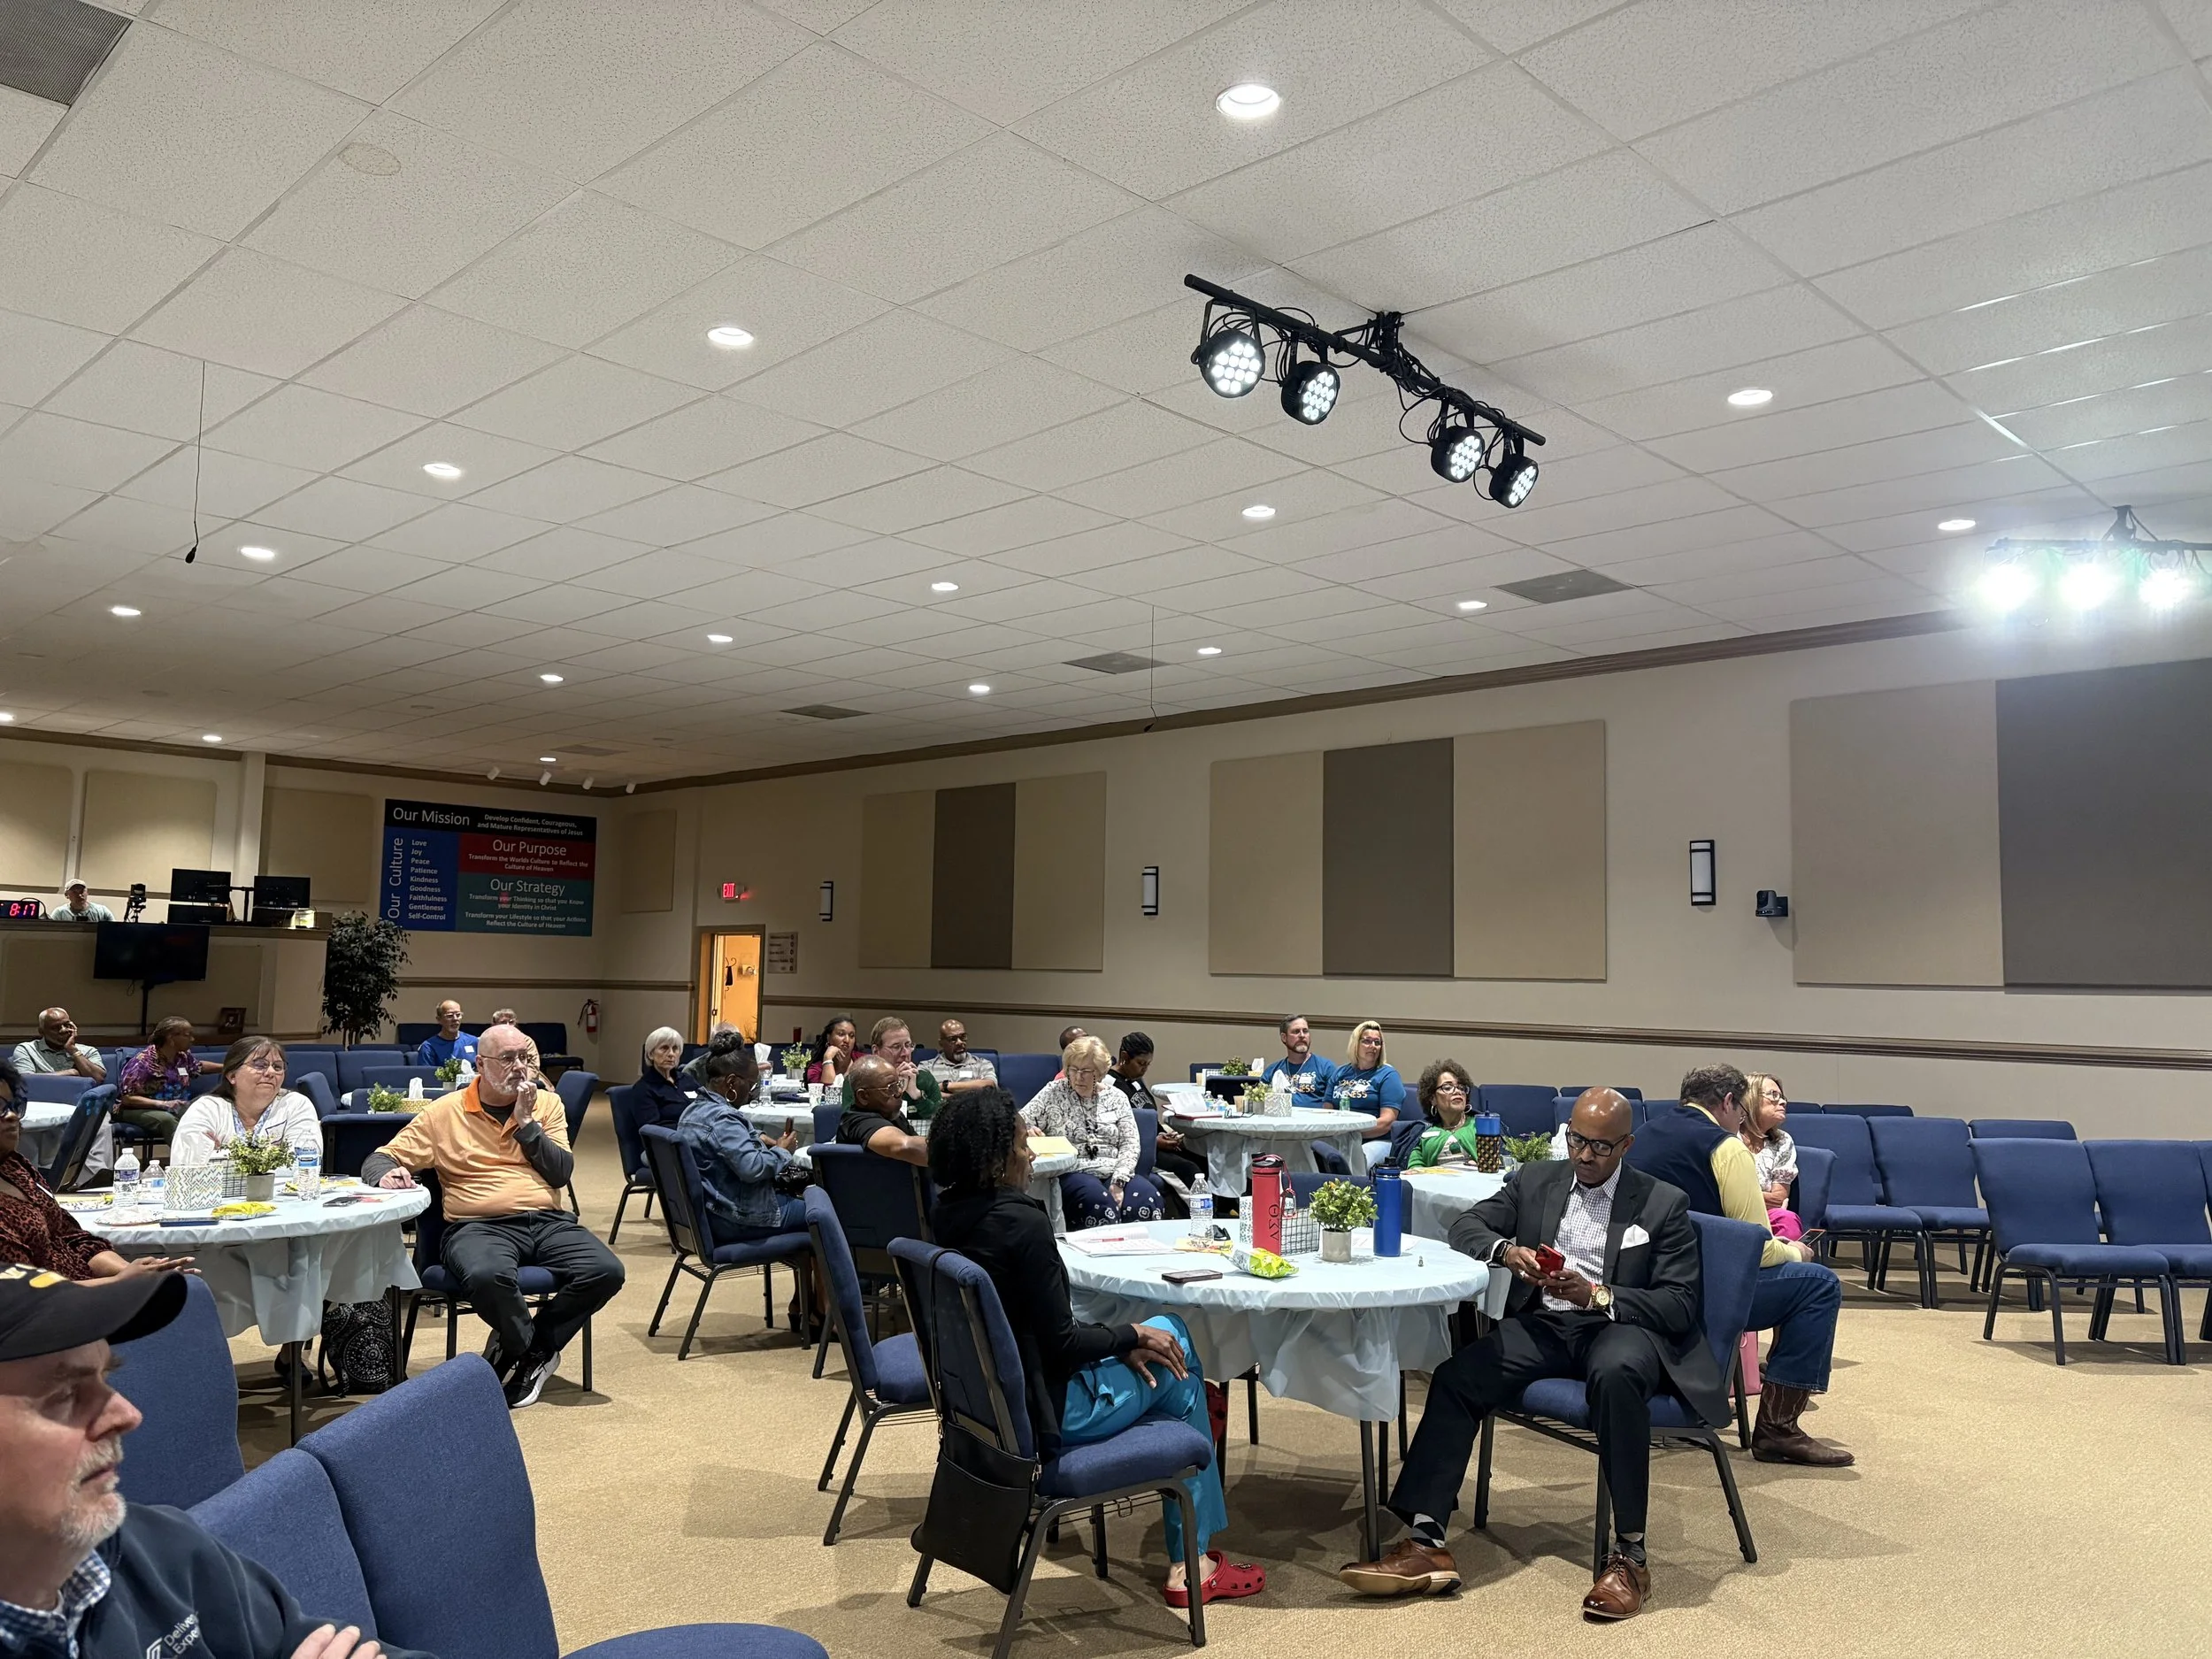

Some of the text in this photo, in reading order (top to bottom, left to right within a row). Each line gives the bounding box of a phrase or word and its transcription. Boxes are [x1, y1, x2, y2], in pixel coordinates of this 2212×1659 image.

[393, 807, 470, 826] Our Mission
[485, 814, 509, 823] Develop
[541, 819, 577, 828] Courageous,
[513, 825, 559, 834] Representatives
[493, 839, 567, 856] Our Purpose
[388, 837, 403, 918] Our Culture
[490, 879, 565, 896] Our Strategy
[723, 883, 734, 897] EXIT
[9, 902, 35, 917] 8:17
[1333, 1090, 1368, 1099] ONENESS
[164, 1612, 199, 1647] Delive
[173, 1624, 200, 1655] Expe
